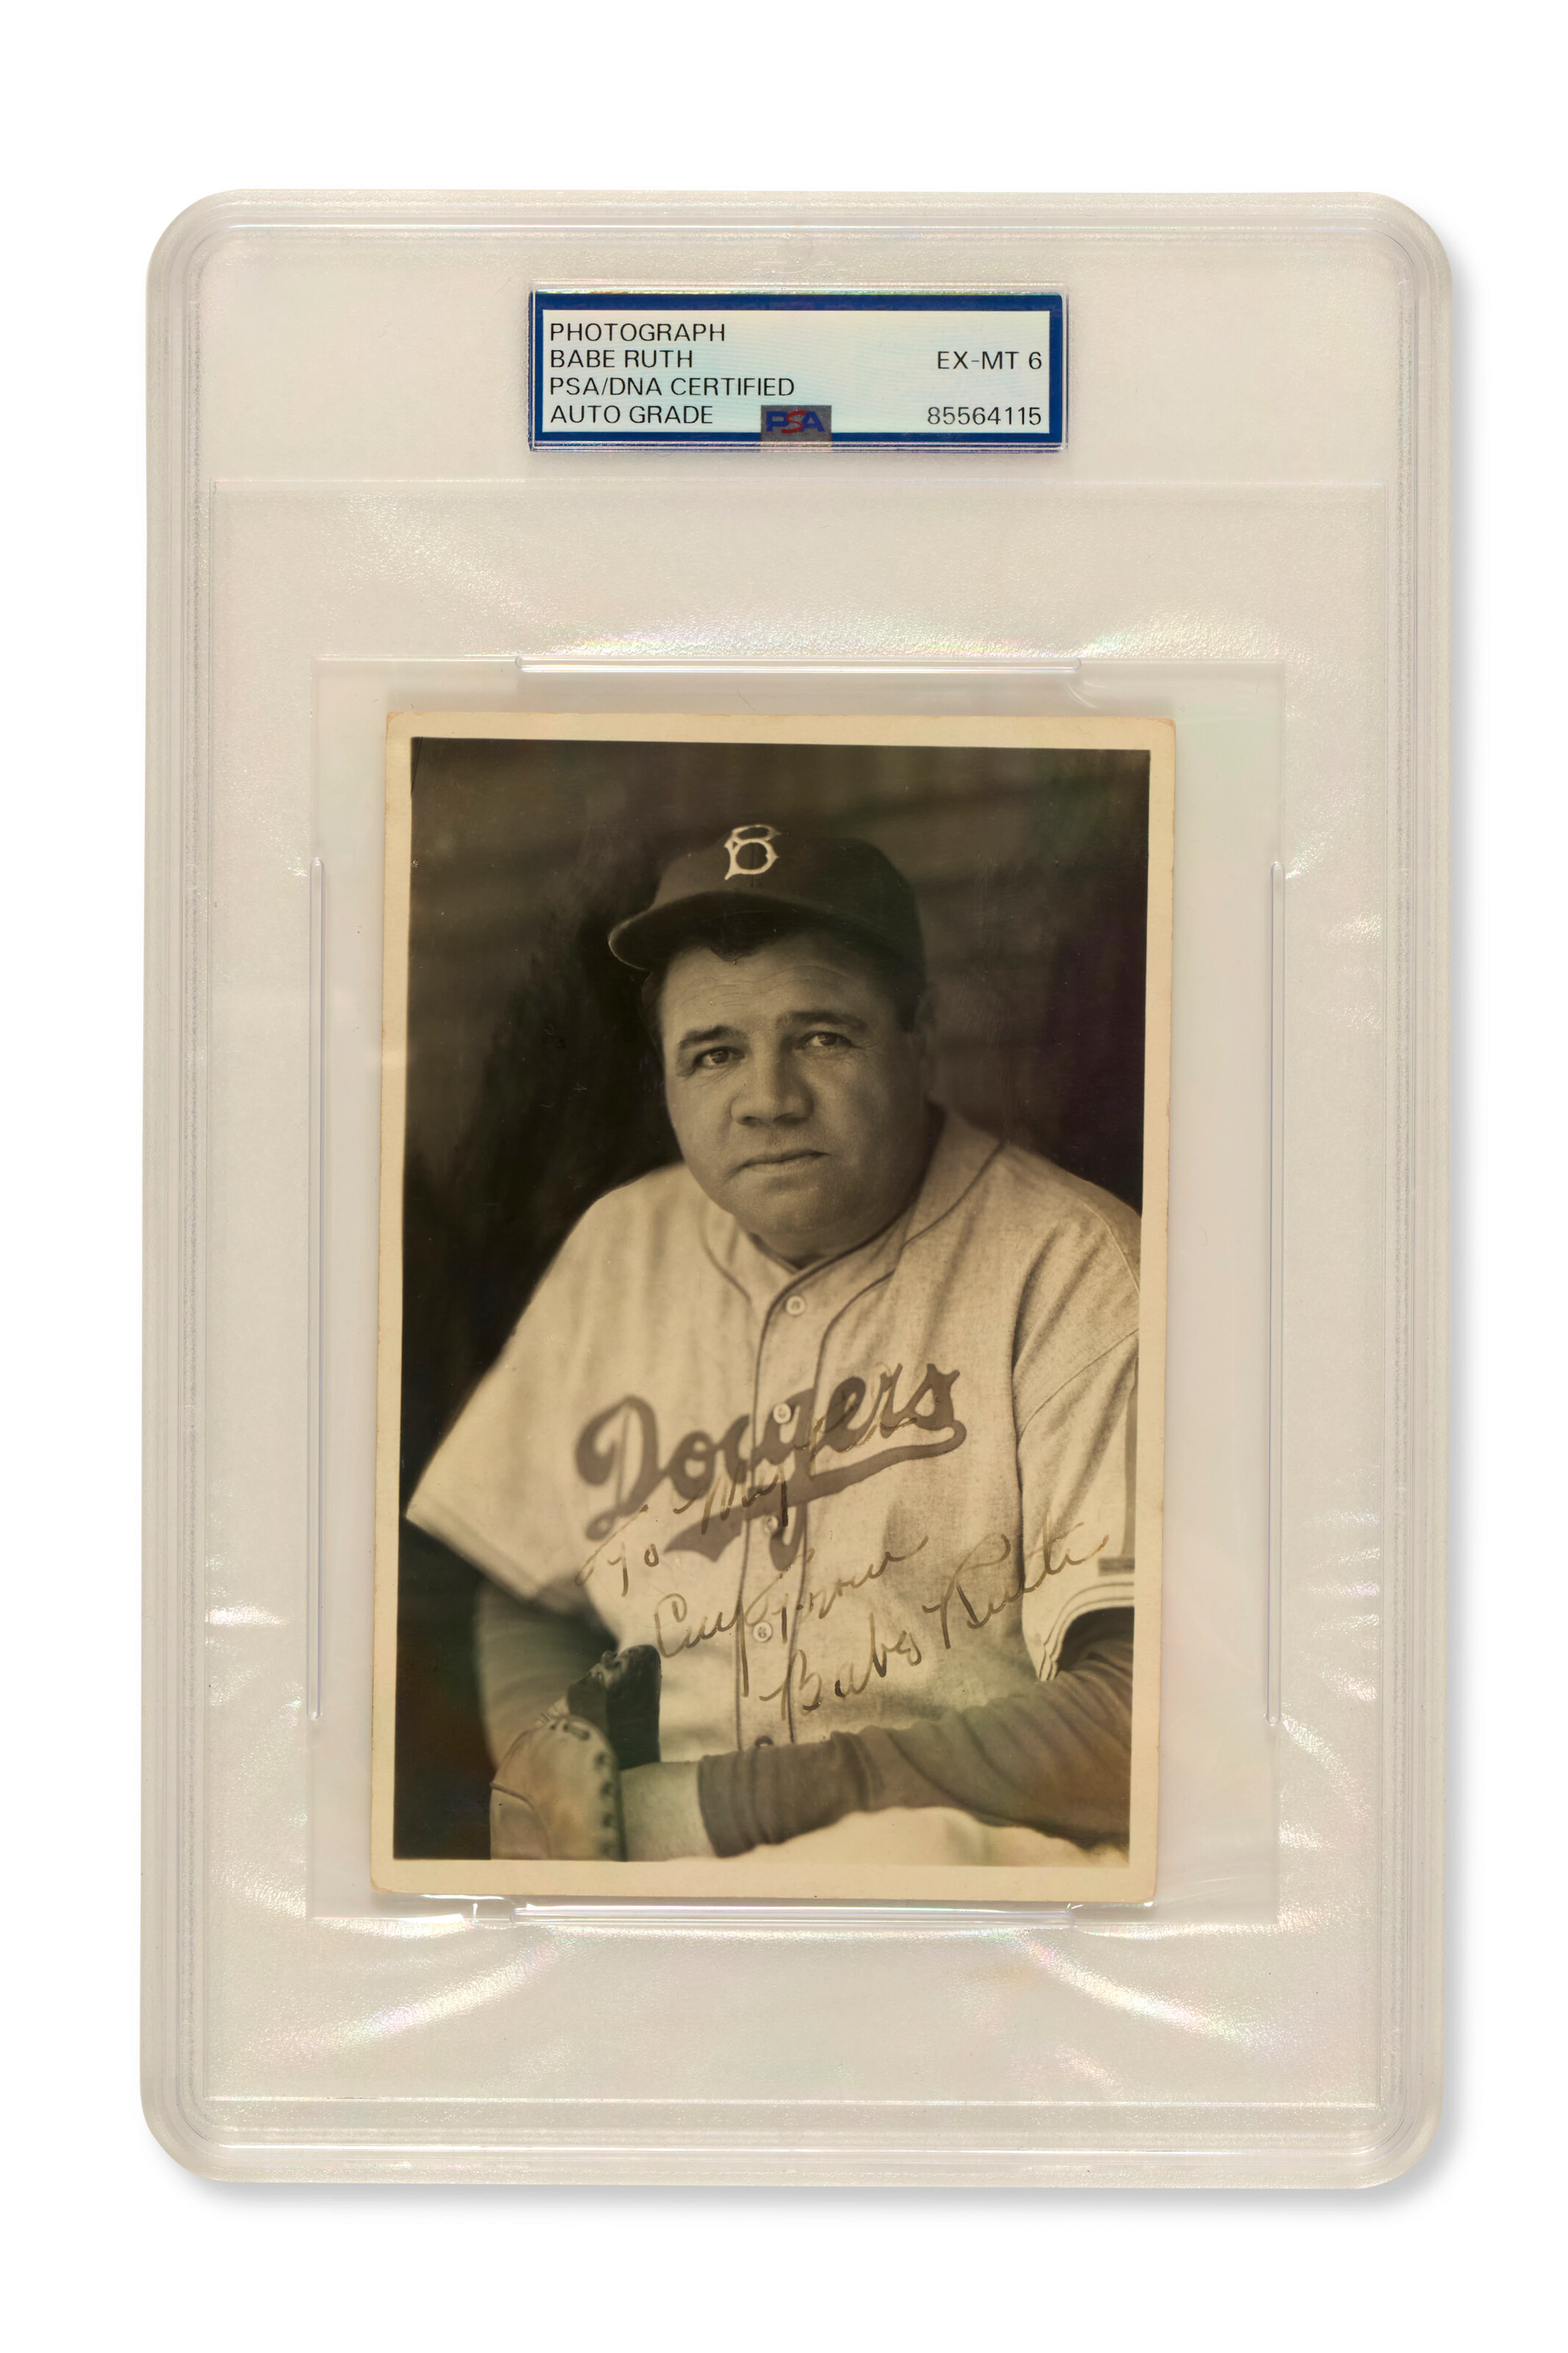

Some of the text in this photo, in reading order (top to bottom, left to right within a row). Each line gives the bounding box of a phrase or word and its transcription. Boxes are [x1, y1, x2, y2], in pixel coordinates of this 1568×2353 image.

[550, 323, 725, 342] PHOTOGRAPH
[550, 349, 693, 368] BABE RUTH
[938, 350, 1042, 370] EX-MT 6
[550, 377, 795, 396] PSA/DNA CERTIFIED
[550, 405, 713, 424] AUTO GRADE
[766, 410, 825, 433] PSA
[927, 406, 1042, 426] 85564115
[725, 823, 781, 881] B
